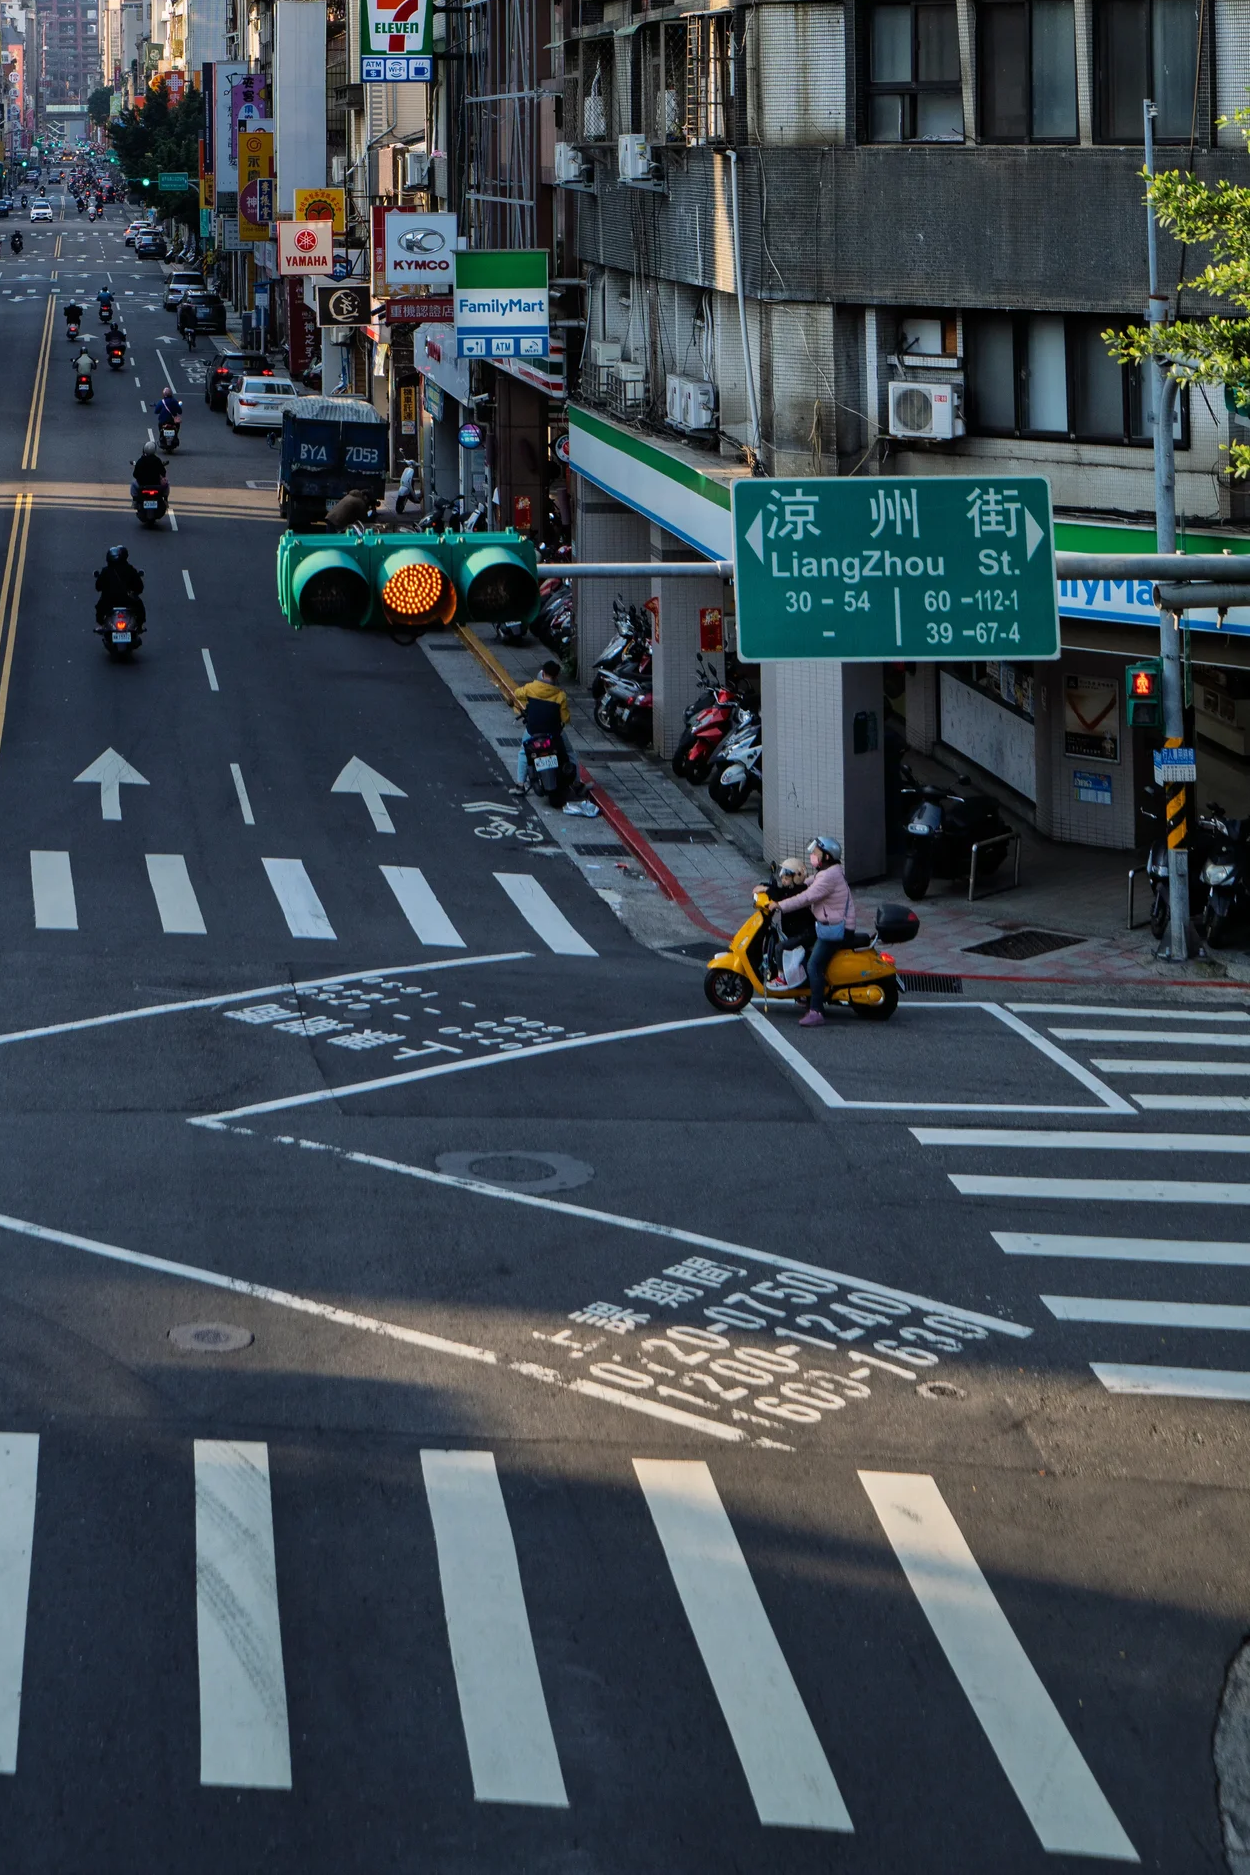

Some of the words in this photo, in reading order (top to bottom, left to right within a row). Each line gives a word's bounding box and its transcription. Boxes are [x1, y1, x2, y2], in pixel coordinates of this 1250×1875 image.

[286, 256, 328, 267] YAMAHA
[393, 260, 450, 271] KYMCO
[390, 305, 454, 318] 重機認證店
[459, 299, 544, 316] FamilyMart
[495, 341, 511, 352] ATM
[301, 443, 327, 460] BYA
[345, 447, 379, 462] 7053
[766, 487, 1023, 540] 涼州街
[771, 549, 945, 582] LiangZhou
[978, 549, 1021, 576] St.
[785, 592, 812, 613] 30
[843, 591, 871, 612] 54
[923, 591, 951, 612] 60
[925, 622, 953, 644] 39
